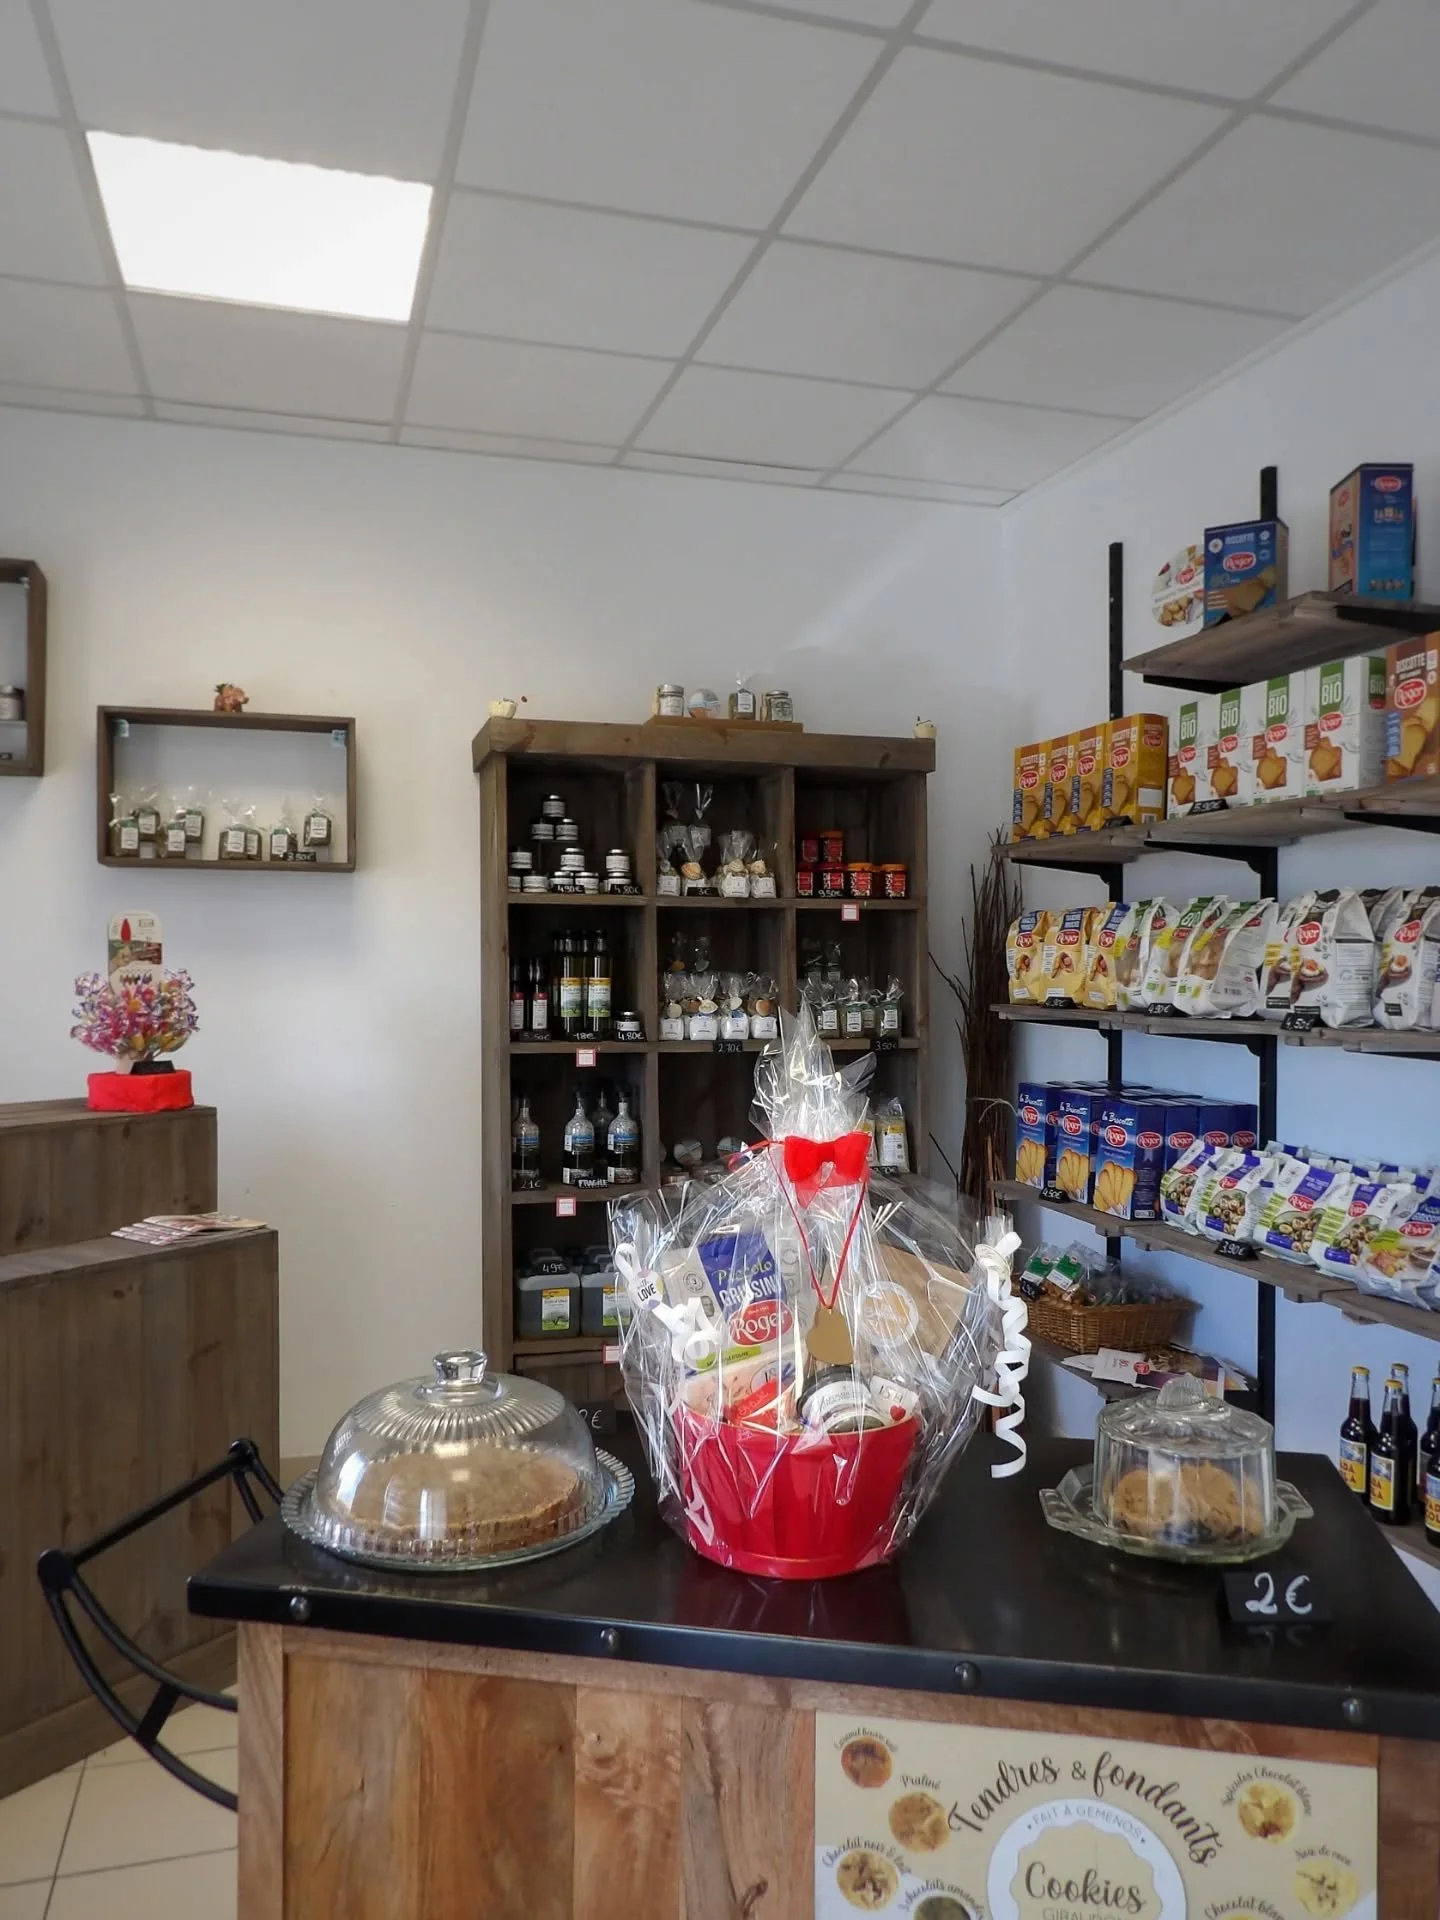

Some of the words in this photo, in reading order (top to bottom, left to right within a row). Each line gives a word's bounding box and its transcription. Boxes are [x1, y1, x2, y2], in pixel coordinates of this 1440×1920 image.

[1321, 681, 1342, 705] BIO
[1268, 694, 1287, 718] BIO
[1181, 719, 1196, 740] BIO
[1221, 707, 1239, 730] BIO
[1106, 1130, 1126, 1146] Roger
[1140, 1136, 1160, 1148] Roger
[1170, 1136, 1193, 1148] Roger
[637, 1283, 657, 1302] LOVE
[900, 1773, 942, 1790] Praliné
[1253, 1767, 1302, 1789] Chocolat
[947, 1755, 1061, 1833] Tendres
[1071, 1760, 1087, 1781] &
[1093, 1751, 1224, 1867] fondants
[1032, 1806, 1058, 1825] FAIT
[1076, 1806, 1143, 1839] GEMENOS
[822, 1835, 862, 1868] Chocolat
[864, 1838, 886, 1853] noir
[1025, 1861, 1147, 1915] Cookies
[1203, 1896, 1256, 1920] Chocolat
